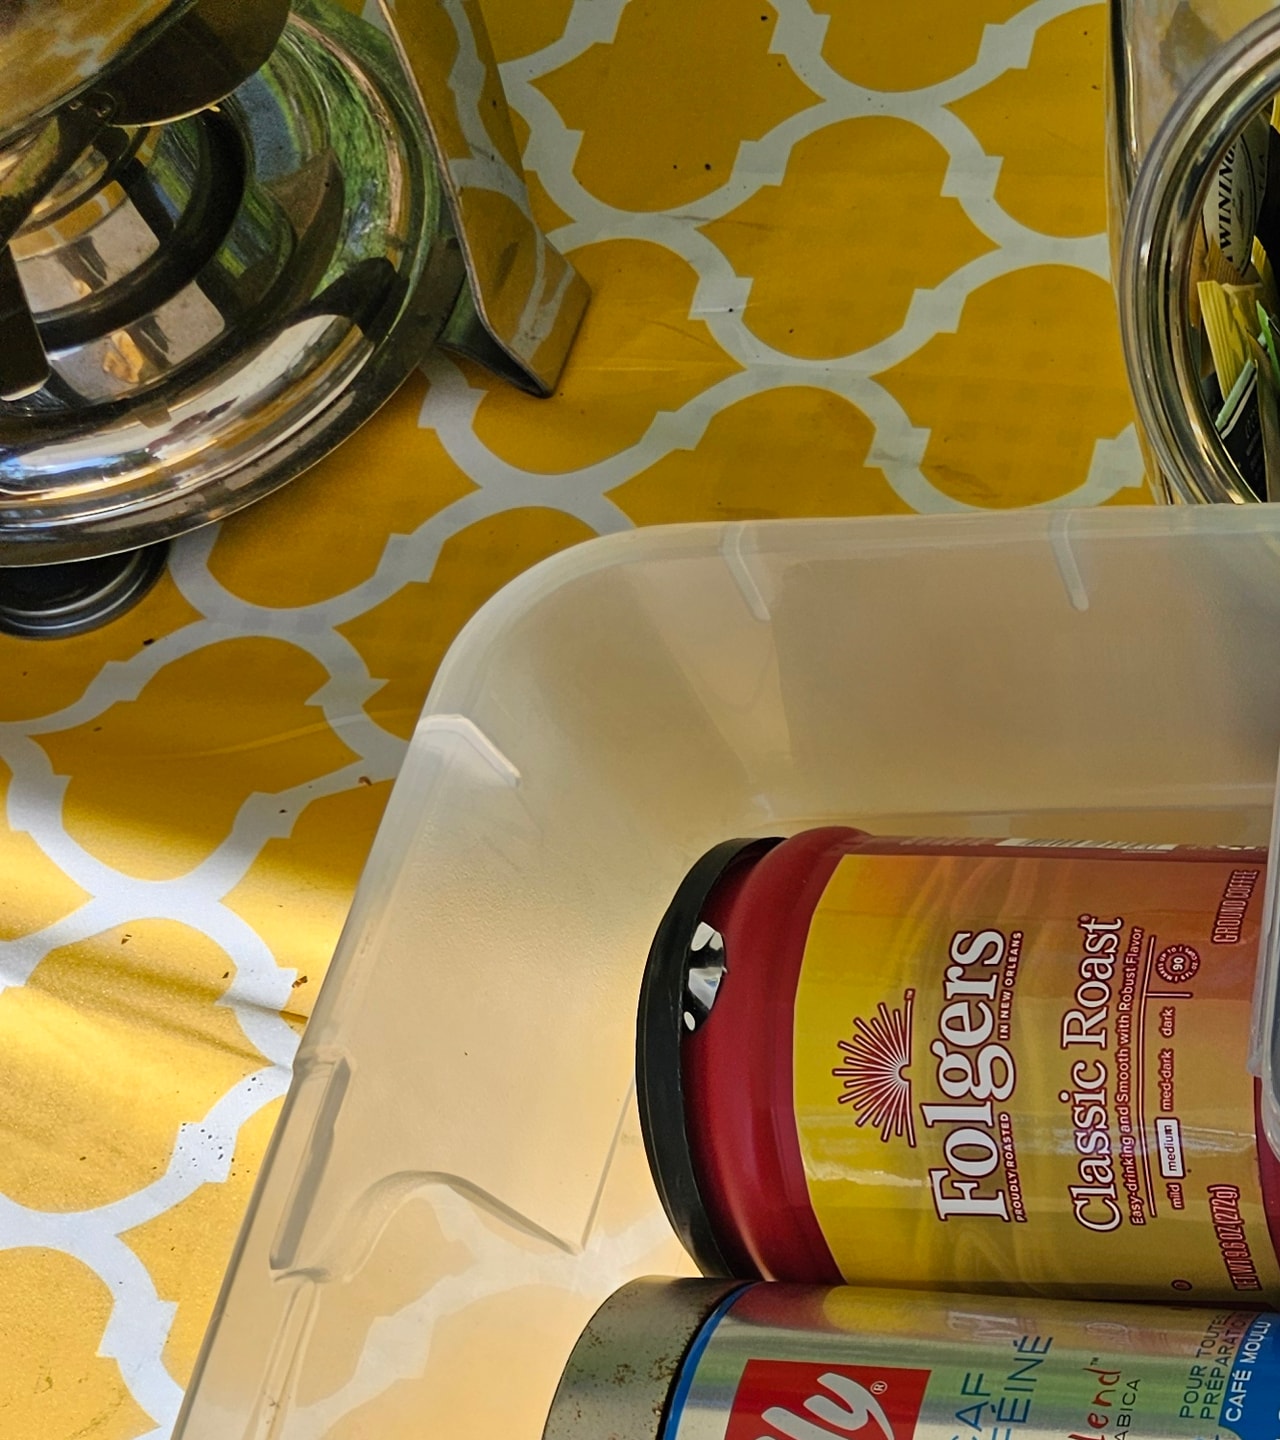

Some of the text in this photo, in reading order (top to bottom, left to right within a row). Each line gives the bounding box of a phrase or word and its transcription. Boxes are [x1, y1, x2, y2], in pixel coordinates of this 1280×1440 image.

[1172, 956, 1184, 972] 90
[920, 927, 1017, 1223] Folgers
[999, 1111, 1028, 1223] PROUDLY ROASTED
[1060, 914, 1124, 1233] Classic Roast
[1116, 927, 1146, 1226] Easy-drinking and Smooth with Robust Flavor
[1159, 1006, 1185, 1210] mild medium med-dark dark
[1225, 1320, 1272, 1423] CAFÉ MOULU
